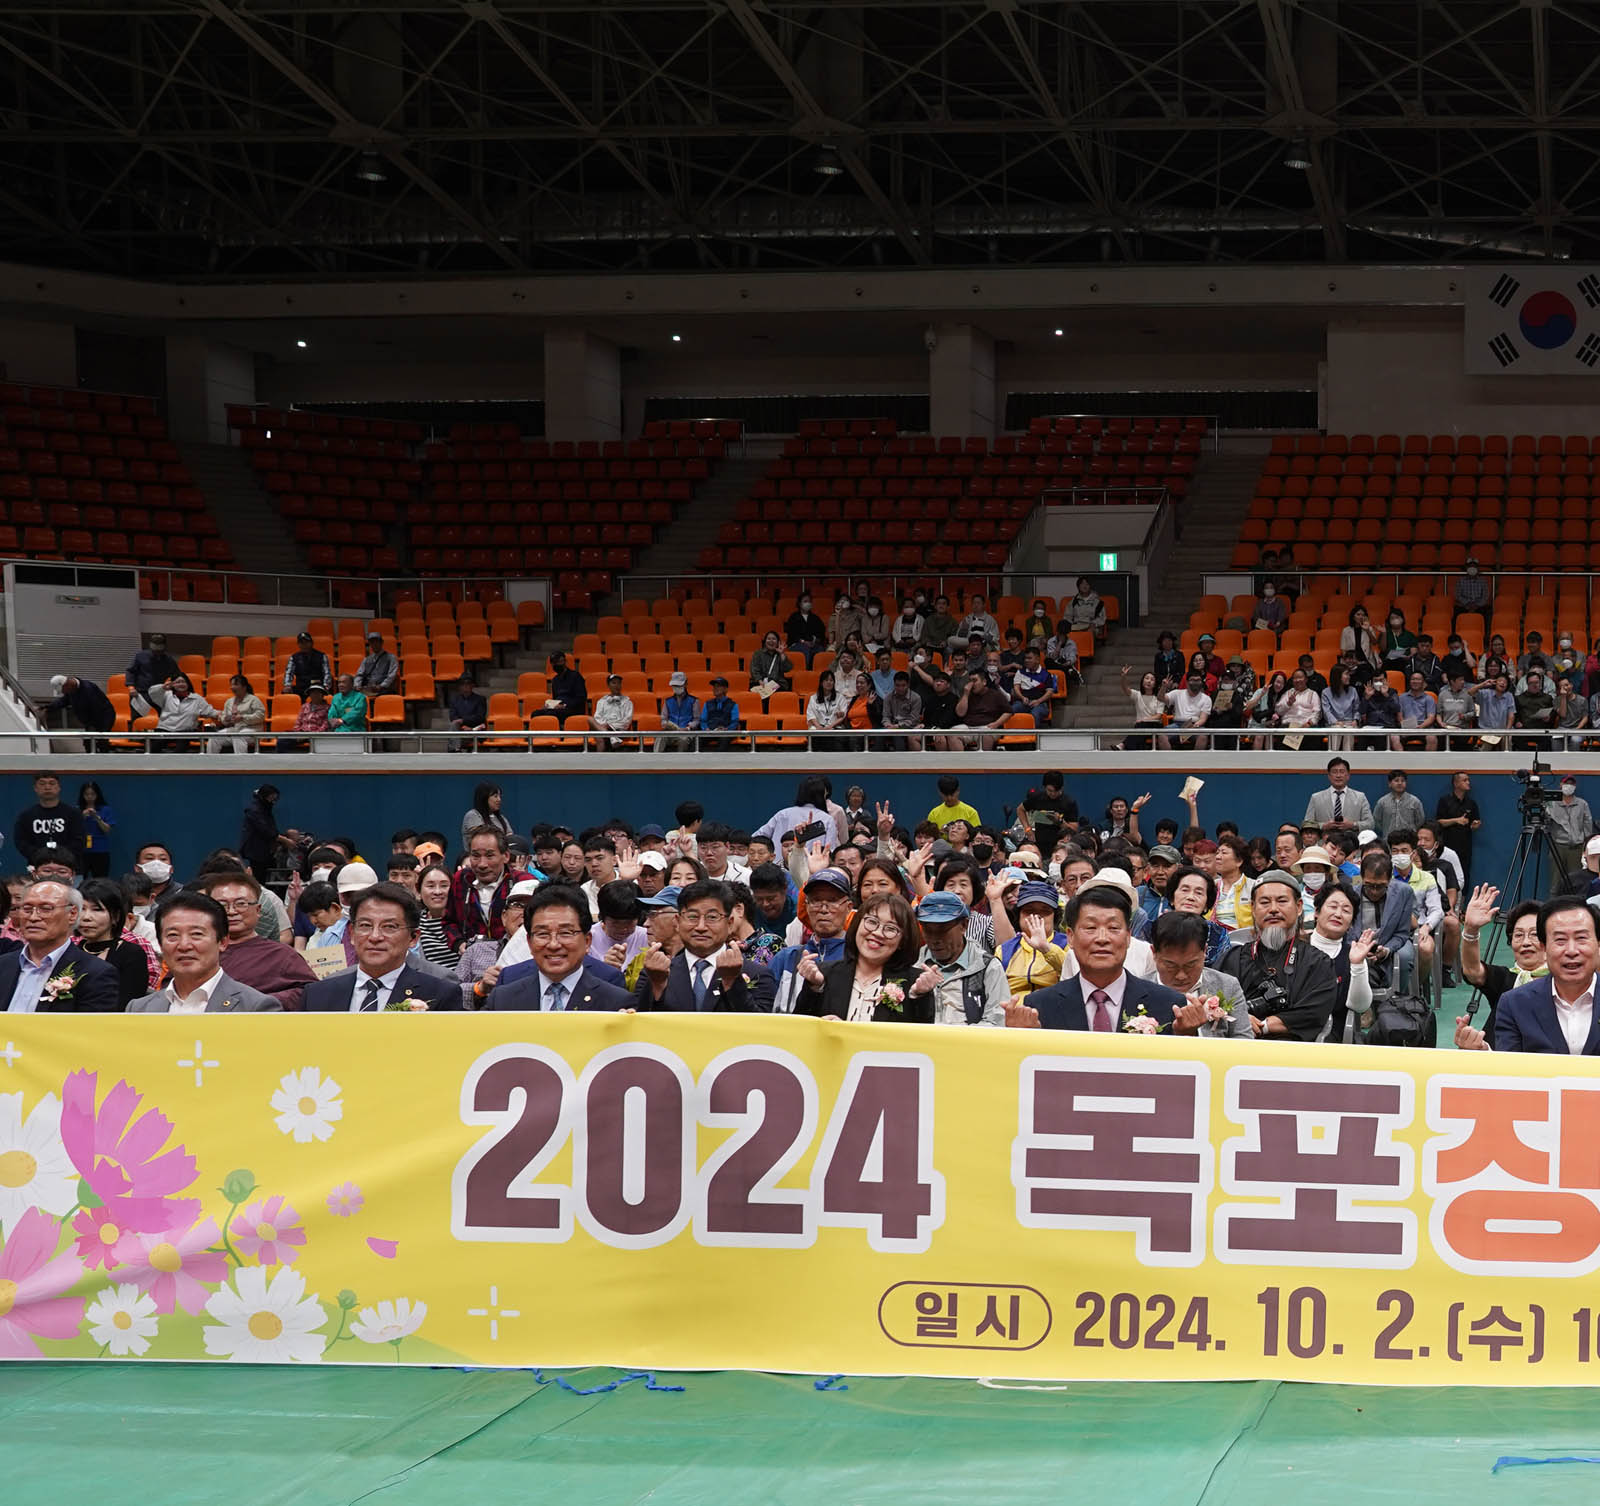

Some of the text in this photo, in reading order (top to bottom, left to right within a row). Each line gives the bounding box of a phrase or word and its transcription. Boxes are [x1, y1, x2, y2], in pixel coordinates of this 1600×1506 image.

[462, 1054, 934, 1241] 2024
[1073, 1291, 1227, 1352] 2024.
[1257, 1286, 1345, 1357] 10.
